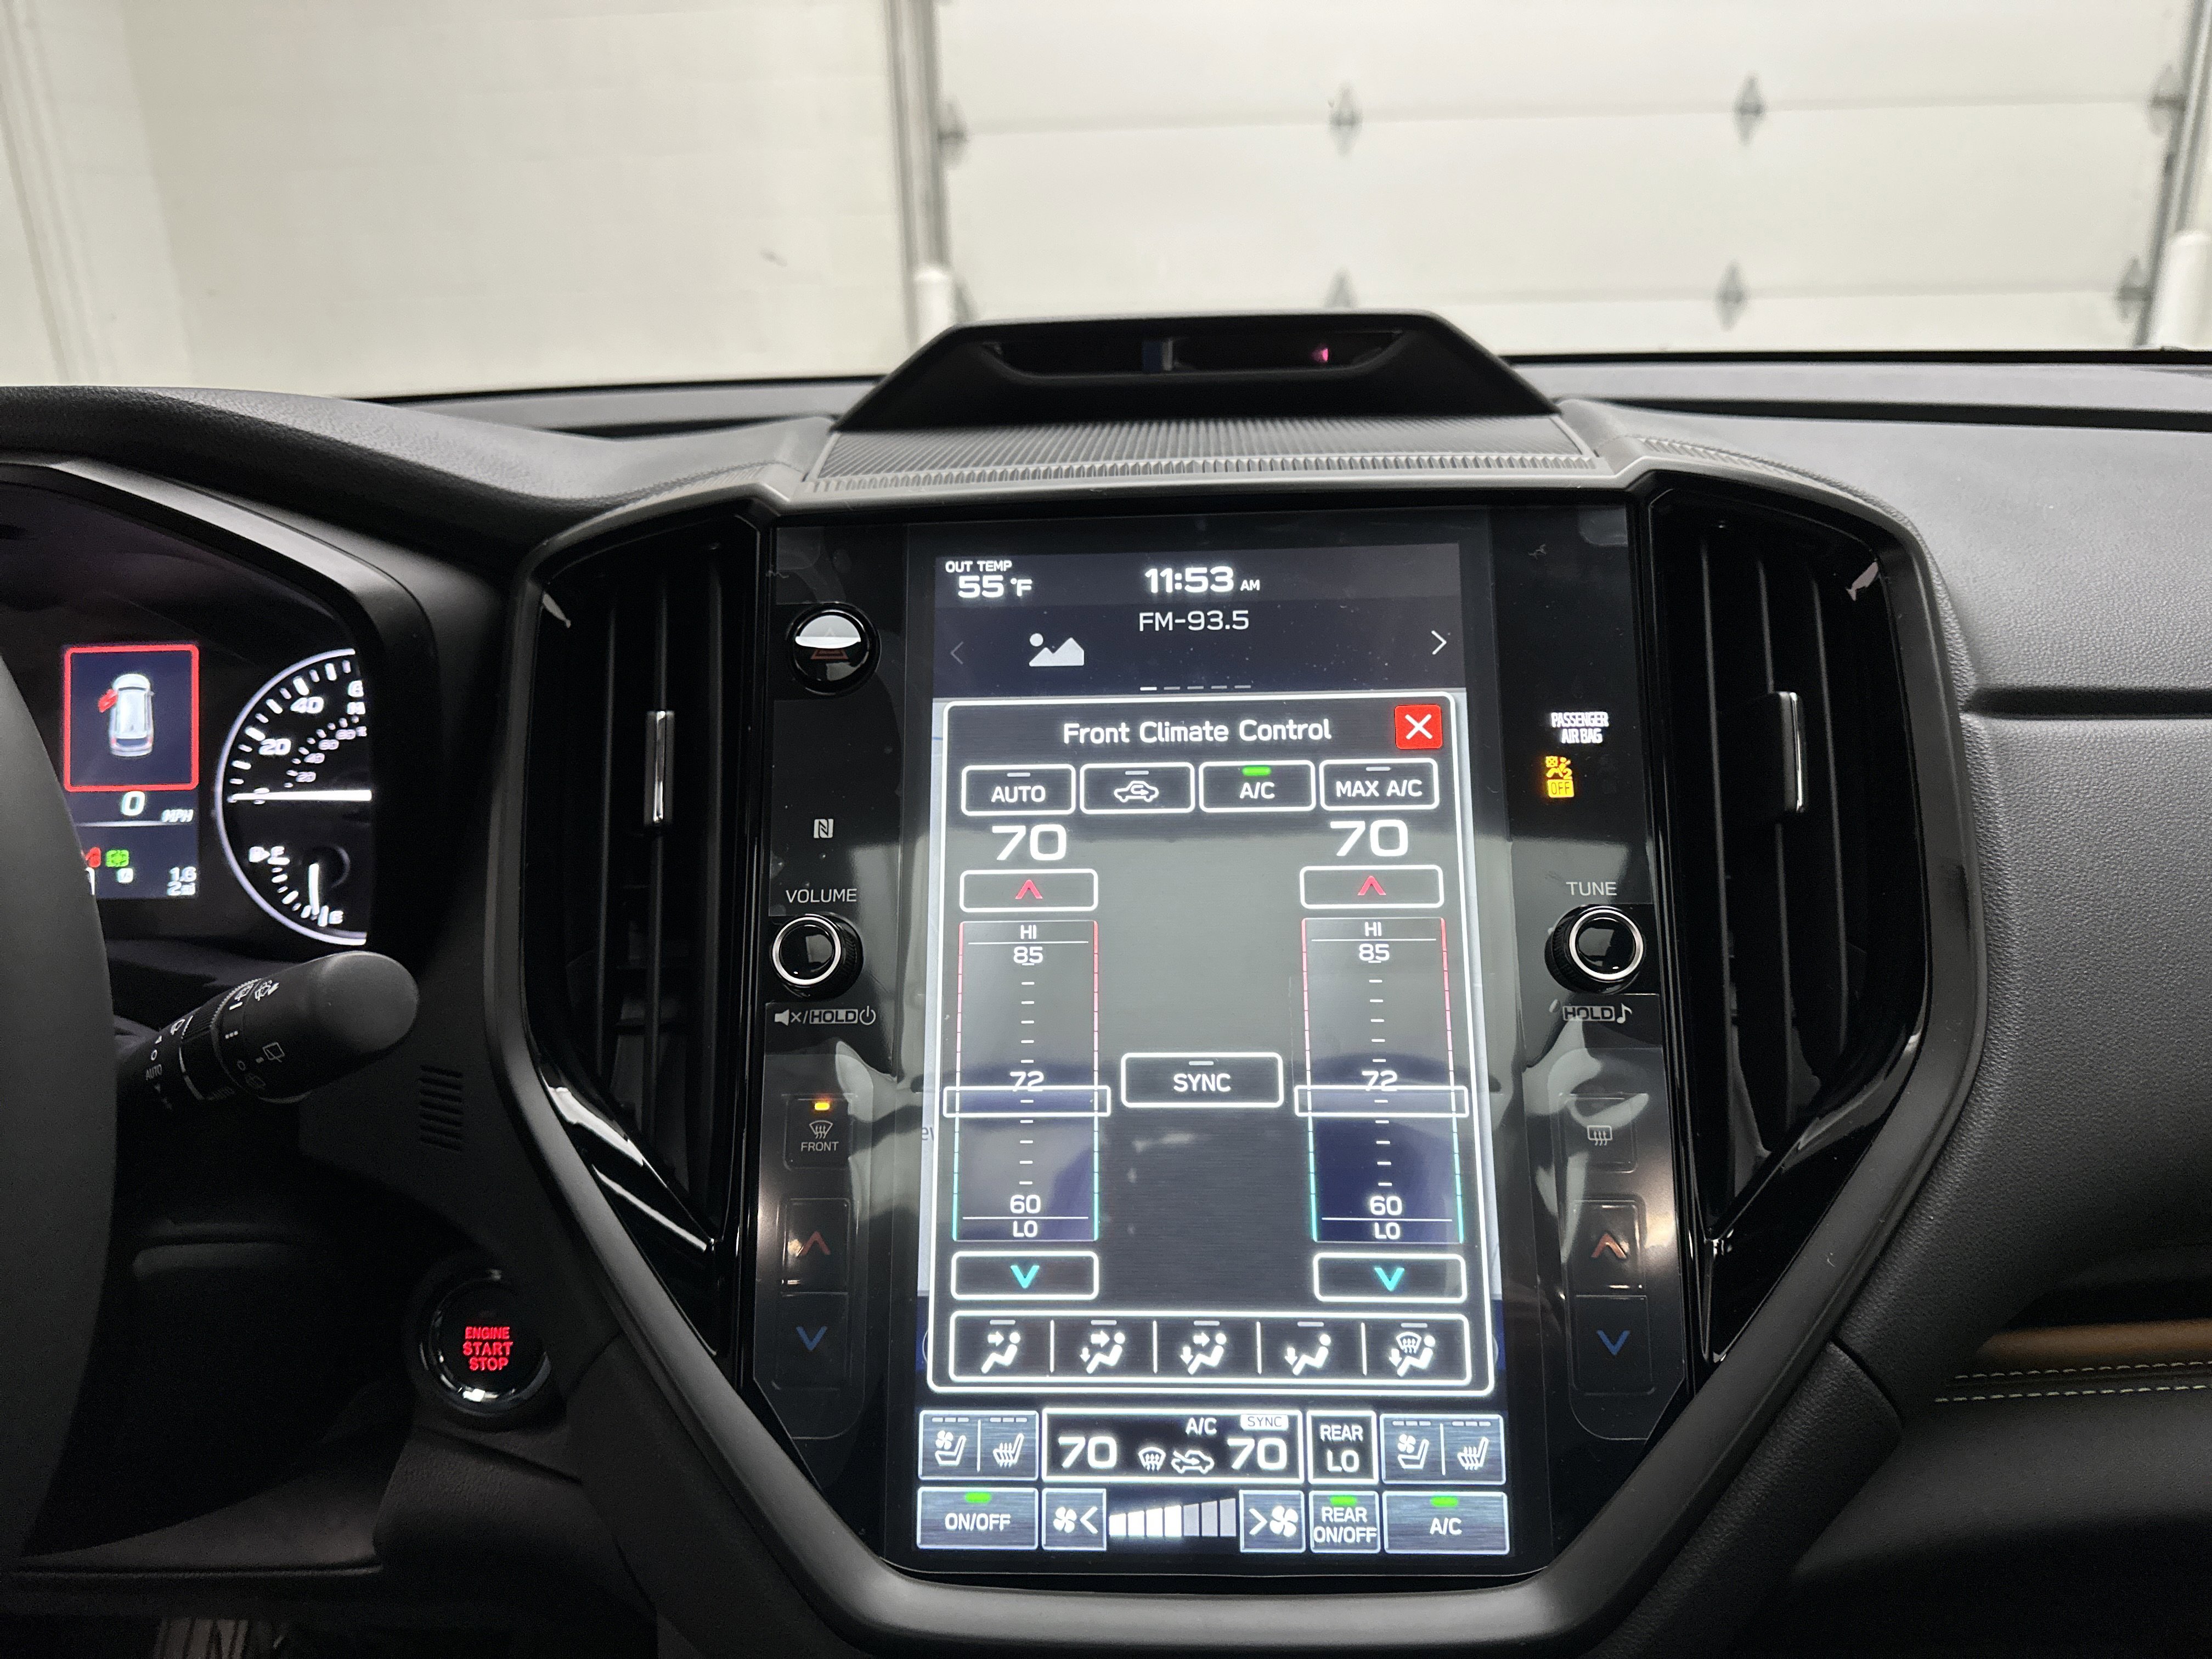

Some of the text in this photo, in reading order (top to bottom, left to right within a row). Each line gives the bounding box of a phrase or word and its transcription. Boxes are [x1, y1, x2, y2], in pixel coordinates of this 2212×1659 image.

[945, 560, 1012, 573] OUT TEMP
[958, 575, 1032, 598] 55 °F
[1144, 566, 1260, 594] 11:53 AM
[1139, 610, 1249, 631] FM-93.5
[291, 697, 324, 713] 40
[1551, 712, 1609, 727] PASSENGER
[1064, 718, 1332, 744] Front Climate Control
[1561, 728, 1602, 743] AIR BAG
[259, 738, 291, 755] 20
[991, 785, 1046, 803] AUTO
[1239, 781, 1275, 799] A/C
[1336, 779, 1423, 797] MAX A/C
[1551, 782, 1570, 795] OFF
[121, 791, 145, 816] 0
[162, 809, 194, 822] MPH
[992, 823, 1067, 861] 70
[1330, 819, 1408, 857] 70
[786, 888, 857, 903] VOLUME
[1566, 882, 1617, 896] TUNE
[1020, 924, 1037, 939] HI
[1364, 922, 1382, 936] HI
[1013, 946, 1043, 964] 85
[1358, 943, 1390, 962] 85
[810, 1011, 856, 1023] HOLD
[1564, 1007, 1613, 1020] HOLD
[145, 1064, 162, 1081] AUTO
[1009, 1070, 1045, 1091] 72
[1363, 1070, 1397, 1090] 72
[1173, 1073, 1231, 1092] SYNC
[801, 1141, 839, 1152] FRONT
[1010, 1194, 1041, 1214] 60
[1369, 1195, 1402, 1216] 60
[1013, 1220, 1038, 1238] LO
[1374, 1222, 1401, 1240] LO
[465, 1327, 510, 1339] ENGINE
[463, 1341, 513, 1356] START
[470, 1357, 509, 1370] STOP
[1186, 1417, 1217, 1435] A/C
[1246, 1415, 1283, 1427] SYNC
[1320, 1424, 1363, 1441] REAR
[1058, 1435, 1118, 1469] 70
[1227, 1437, 1288, 1471] 70
[1327, 1449, 1359, 1472] LO
[945, 1513, 1011, 1531] ON/OFF
[1321, 1506, 1368, 1523] REAR
[1313, 1525, 1377, 1545] ON/OFF
[1430, 1517, 1462, 1535] A/C
